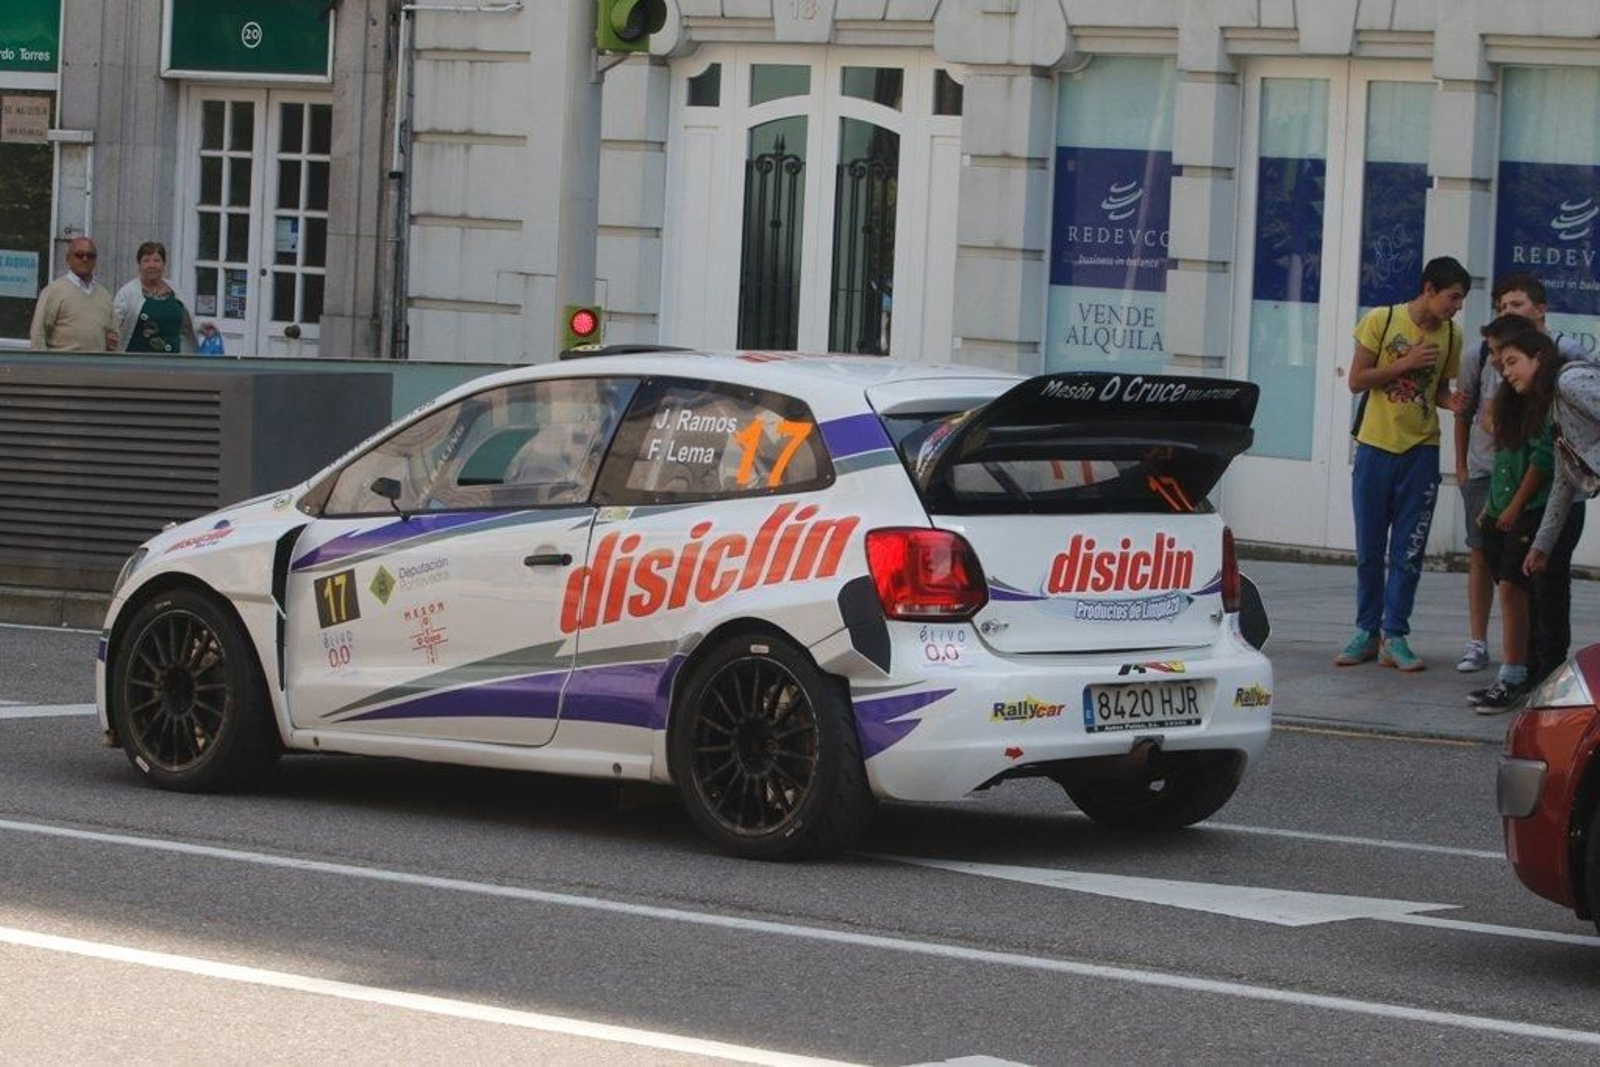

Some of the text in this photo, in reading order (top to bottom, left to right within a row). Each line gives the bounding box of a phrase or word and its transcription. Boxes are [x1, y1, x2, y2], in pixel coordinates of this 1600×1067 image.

[244, 28, 260, 40] 20
[19, 47, 51, 61] Torres
[1078, 302, 1156, 328] VENDE
[1065, 325, 1164, 354] ALQUILA
[1040, 379, 1096, 399] Mesón
[1100, 376, 1121, 401] O
[1122, 376, 1188, 402] Cruce
[655, 408, 738, 433] J. Ramos
[647, 439, 716, 463] F. Lema
[734, 414, 814, 488] 17
[559, 500, 862, 635] disiclin
[1047, 532, 1195, 595] disiclin
[324, 573, 348, 624] 17
[404, 602, 444, 620] MESON
[1075, 600, 1129, 620] Productos
[1129, 601, 1142, 620] de
[993, 701, 1066, 720] Rallycar
[1098, 685, 1200, 721] 8420 HJR
